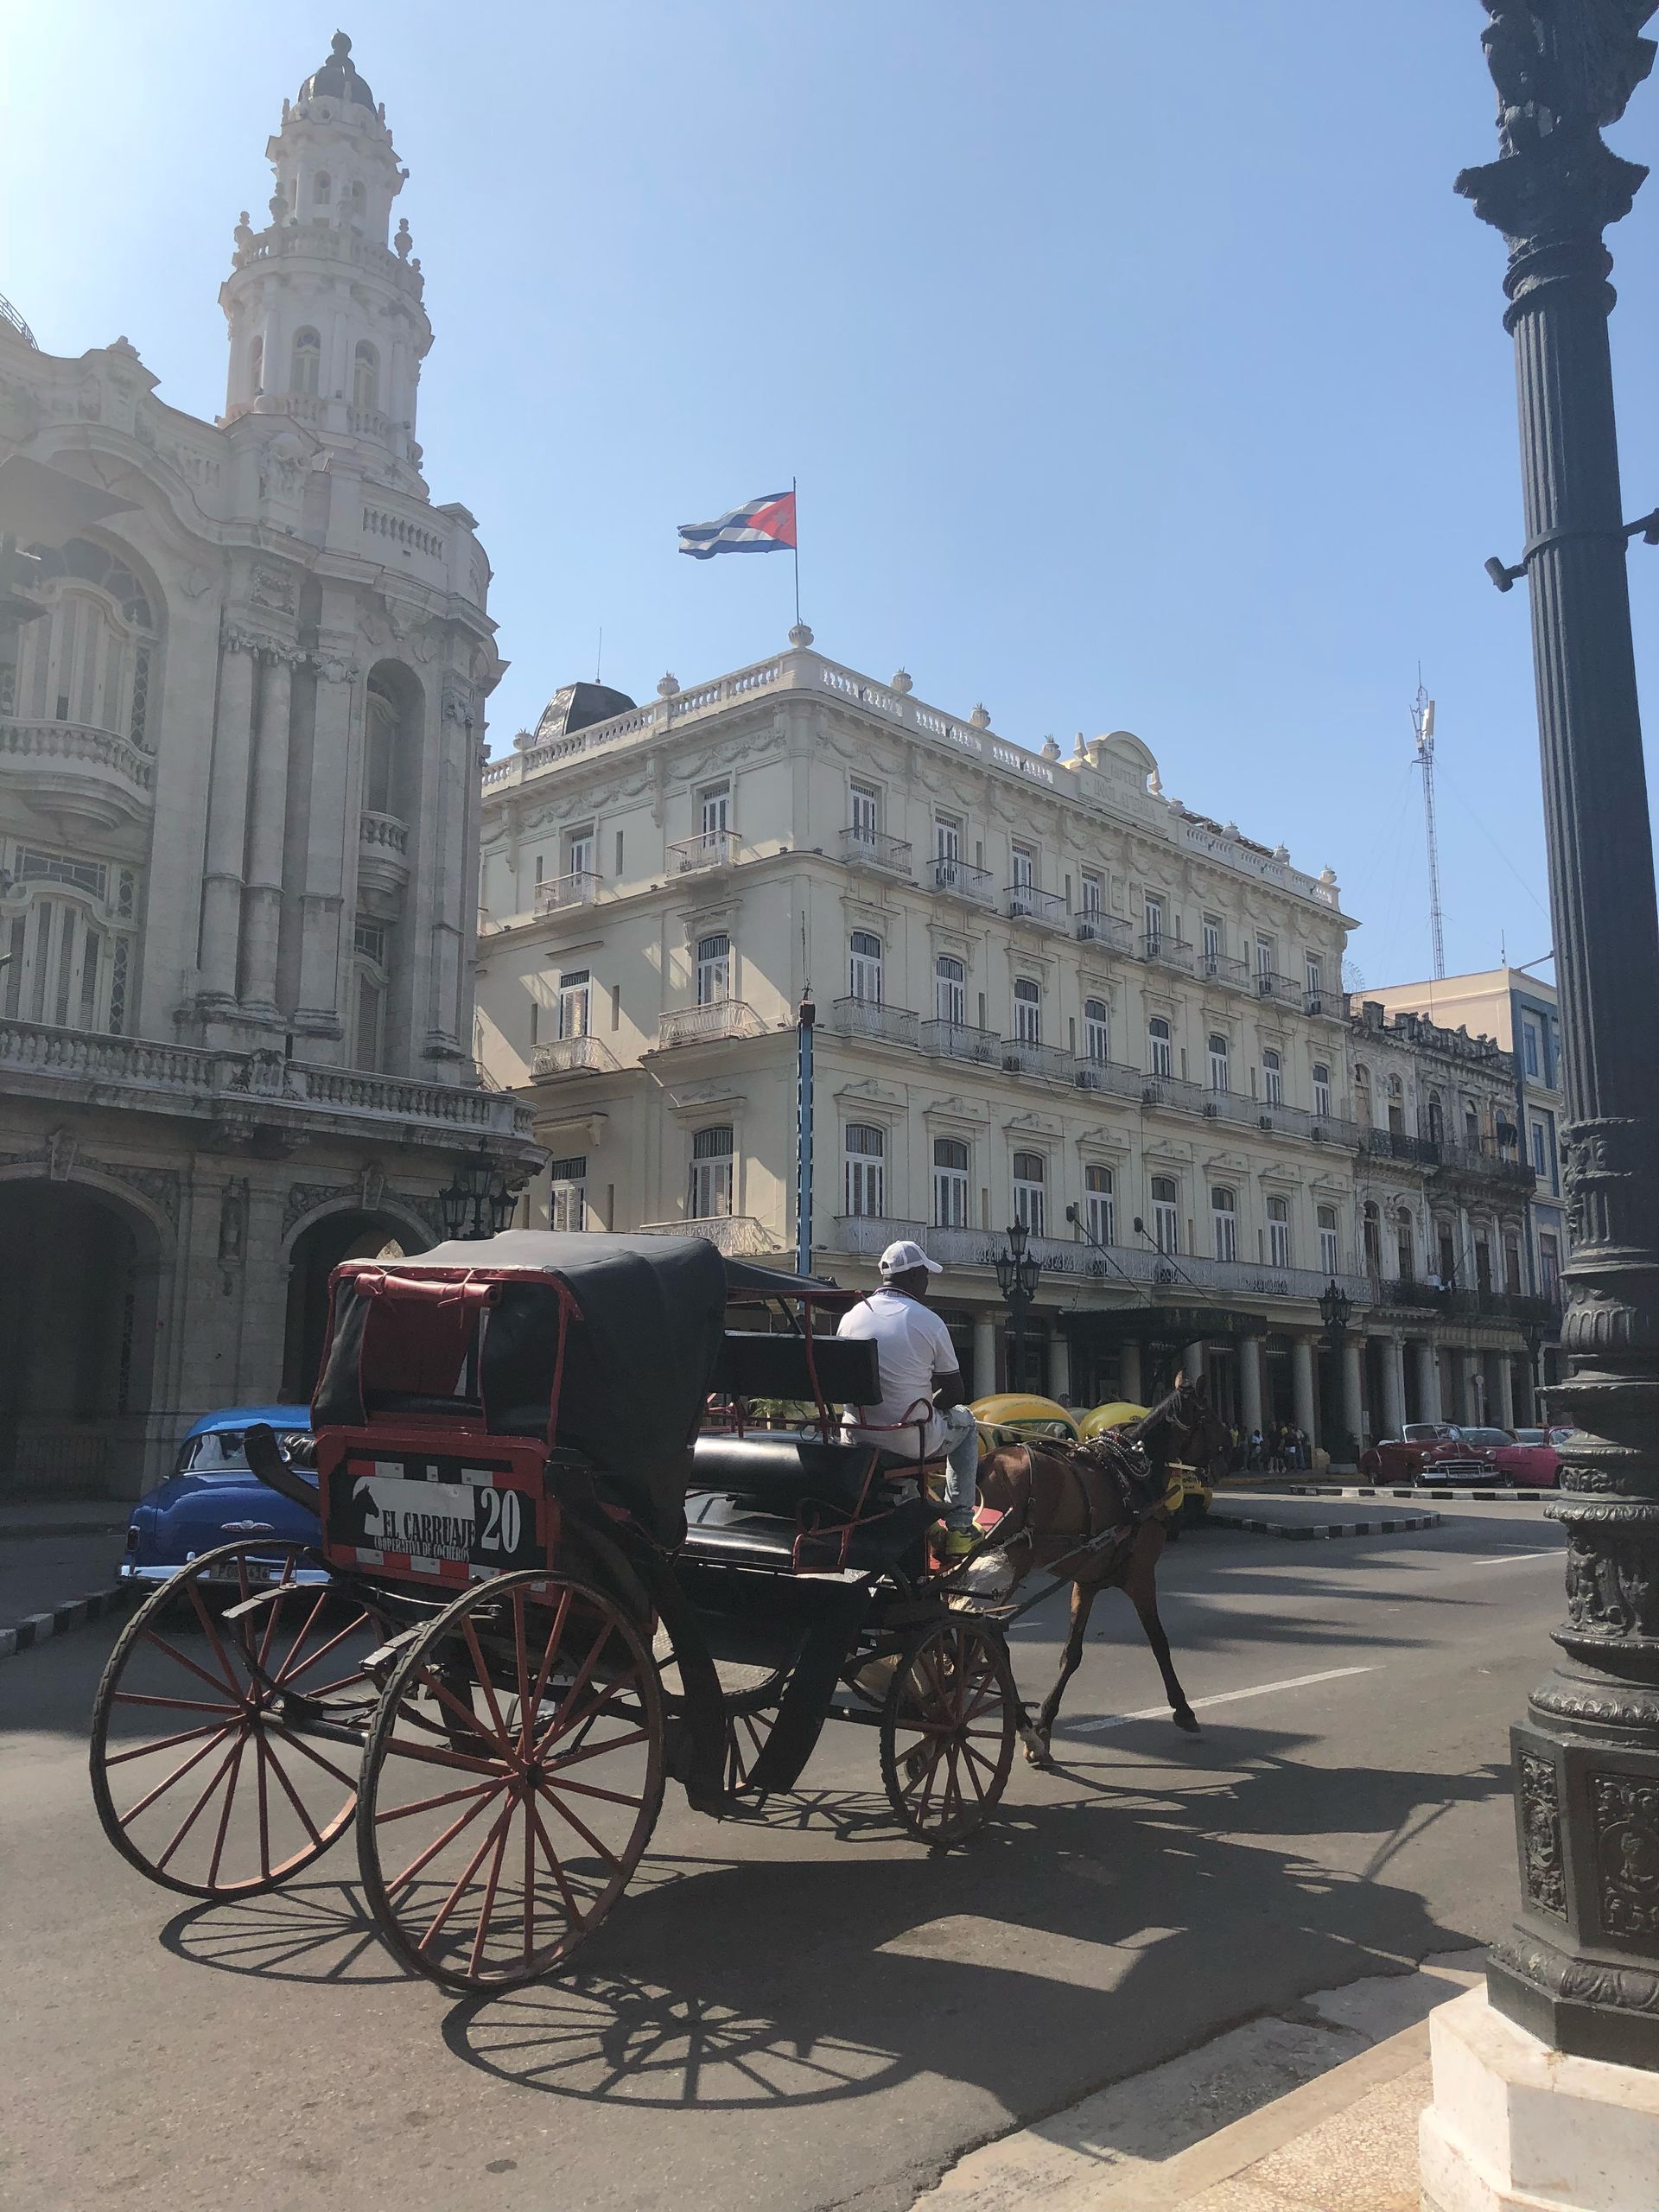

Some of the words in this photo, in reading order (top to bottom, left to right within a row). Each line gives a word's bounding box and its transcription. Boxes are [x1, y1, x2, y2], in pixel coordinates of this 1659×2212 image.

[382, 1510, 398, 1539] EL
[404, 1512, 475, 1548] CARRUAJE
[480, 1487, 521, 1554] 20
[374, 1535, 421, 1556] COOPERATIVA
[422, 1541, 432, 1556] DE
[433, 1543, 470, 1563] COCHEROS
